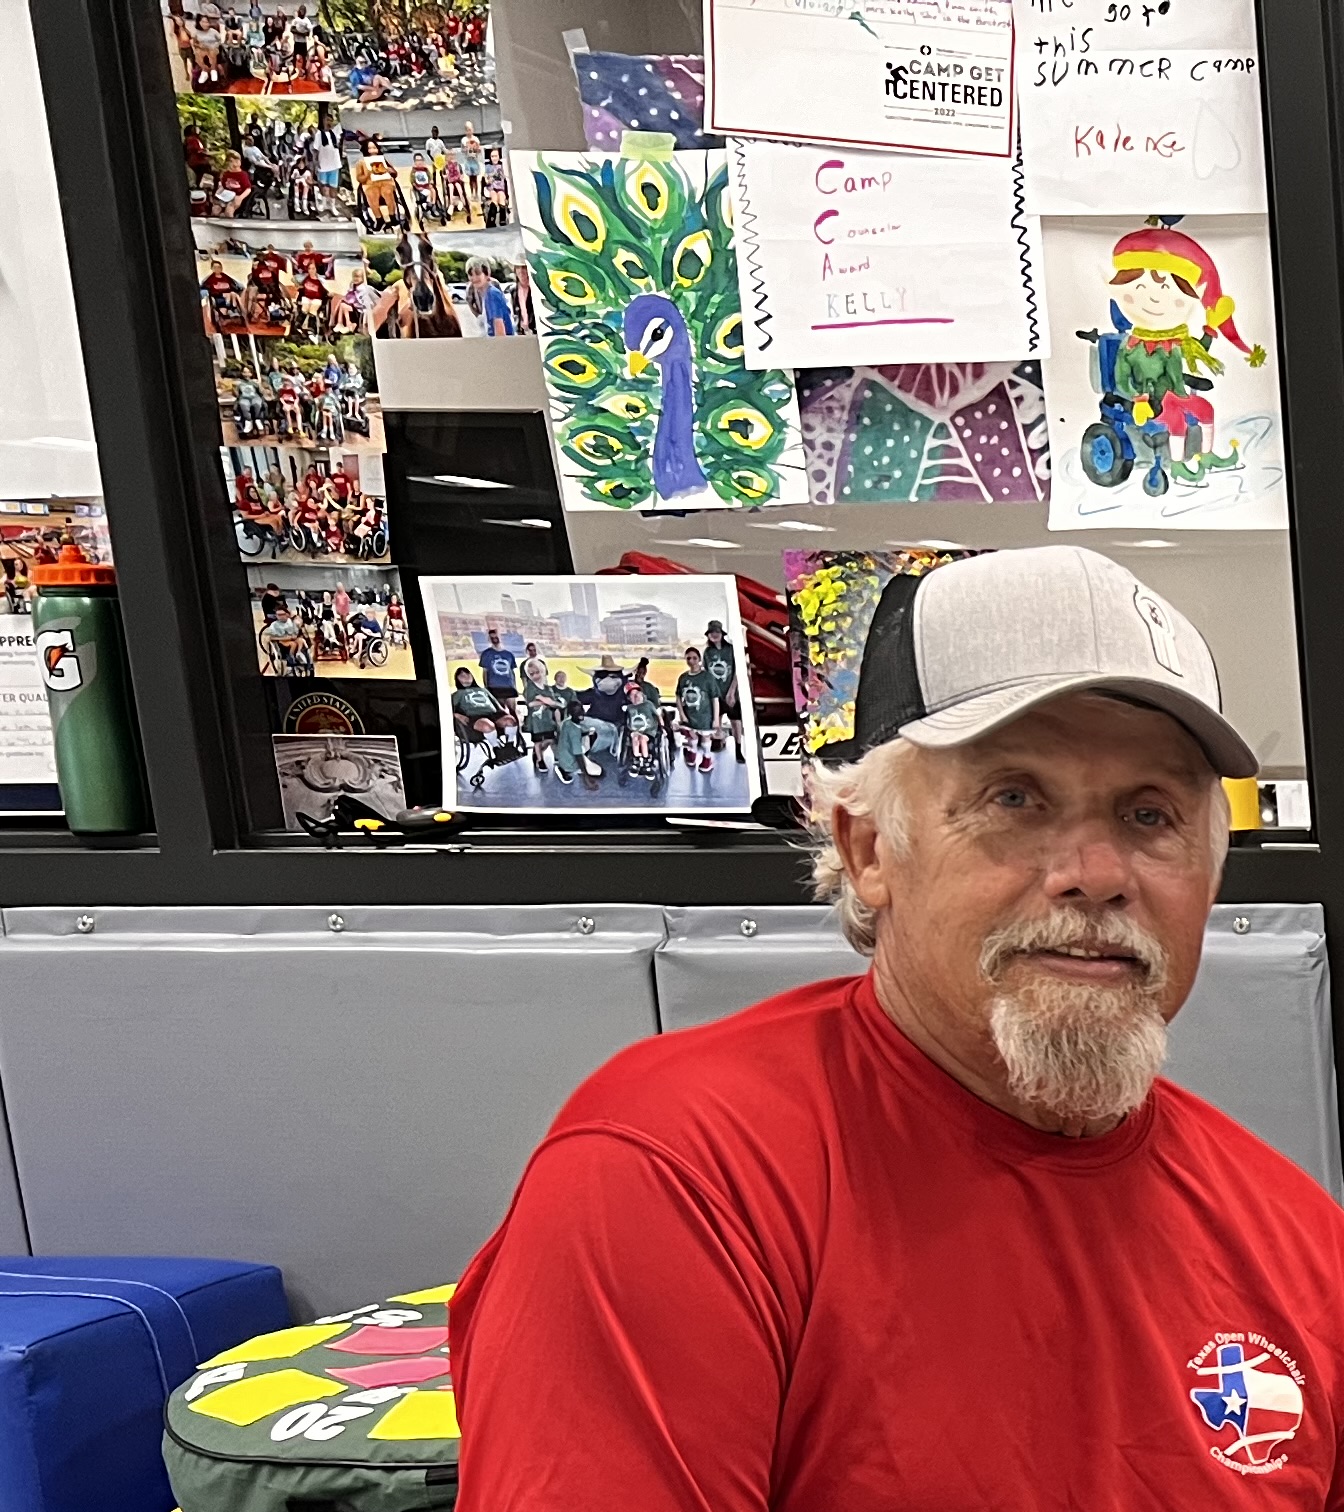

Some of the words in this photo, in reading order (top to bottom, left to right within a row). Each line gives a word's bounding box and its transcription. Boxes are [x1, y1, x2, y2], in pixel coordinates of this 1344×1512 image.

[1104, 3, 1132, 24] go
[1033, 26, 1094, 57] this
[908, 59, 964, 78] CAMP
[969, 64, 1005, 83] GET
[893, 79, 1004, 107] CENTERED
[934, 107, 956, 118] 2022
[815, 159, 893, 195] Camp
[822, 252, 871, 282] Award
[826, 286, 907, 319] KELLY
[36, 629, 83, 692] G
[1187, 1340, 1217, 1370] Texas
[1214, 1332, 1245, 1345] Open
[1247, 1331, 1306, 1386] Wheelchair
[271, 1402, 375, 1441] 20
[1210, 1446, 1289, 1475] Championships
